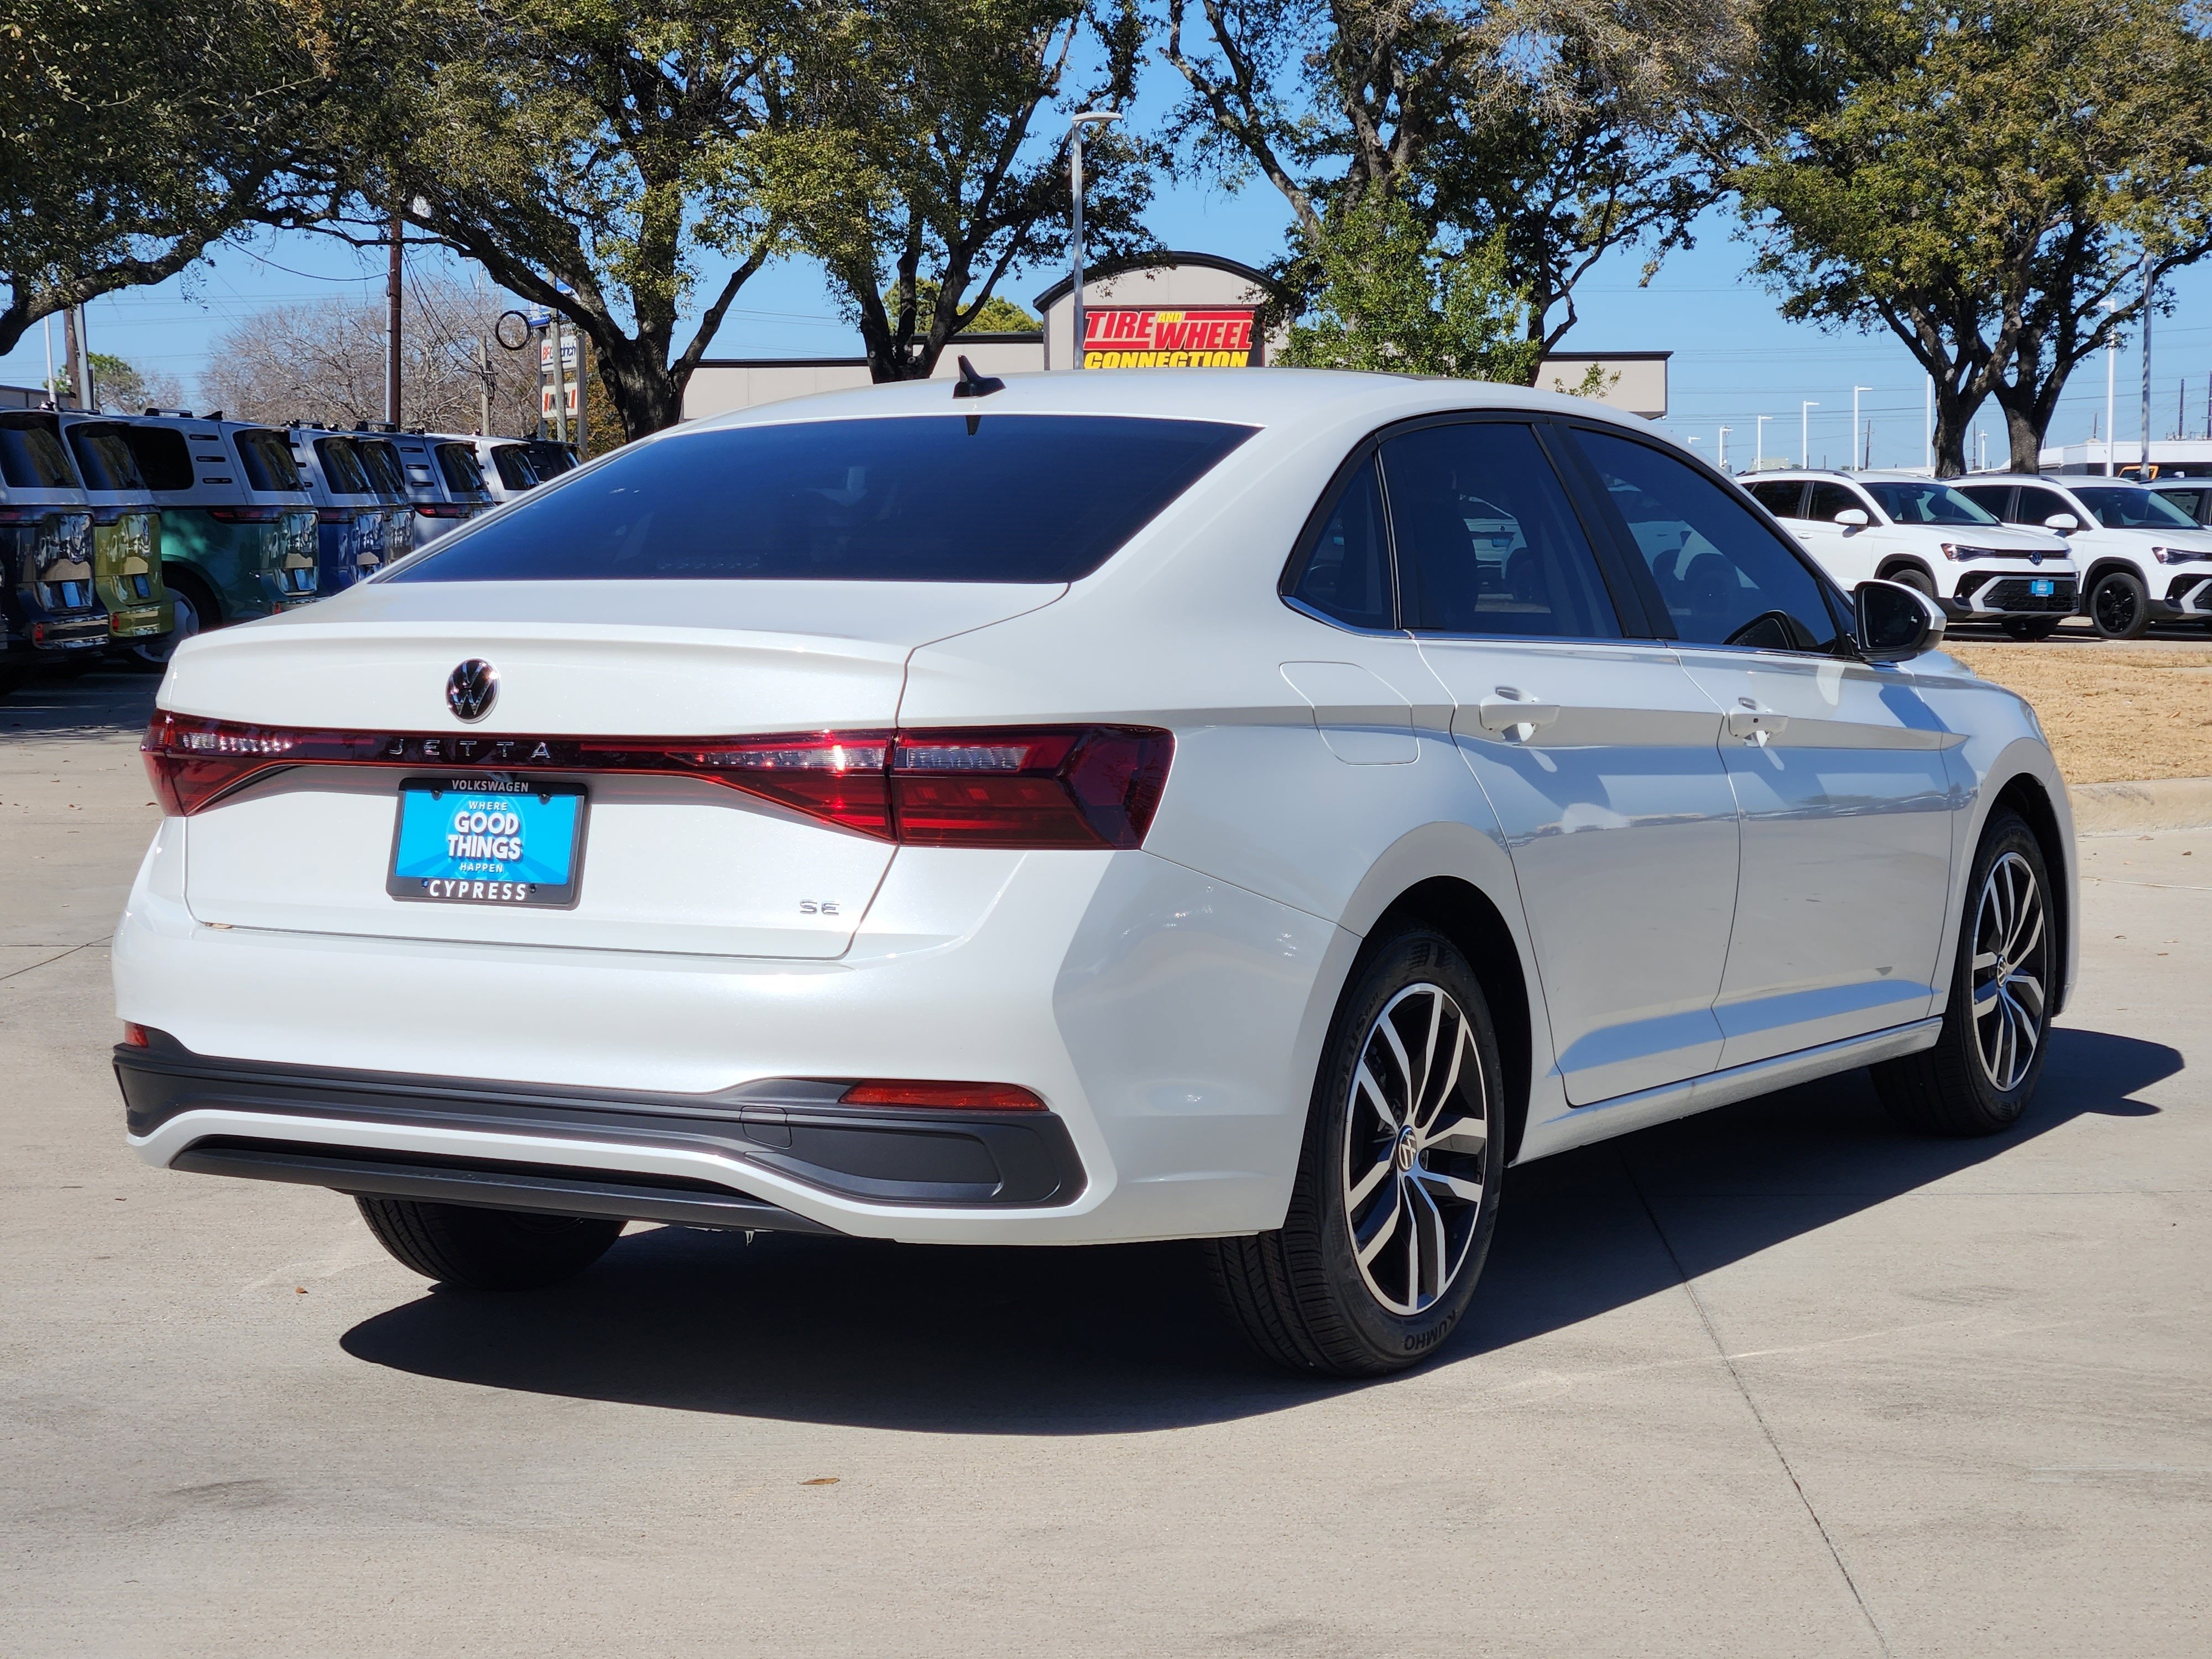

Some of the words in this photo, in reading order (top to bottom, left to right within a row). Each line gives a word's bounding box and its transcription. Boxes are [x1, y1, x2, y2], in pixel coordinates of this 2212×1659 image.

[1086, 311, 1156, 339] TIRE
[1157, 312, 1182, 323] AND
[1155, 320, 1254, 349] WHEEL
[1084, 352, 1249, 369] CONNECTION
[447, 659, 498, 720] VW
[389, 739, 550, 759] JETTA
[452, 780, 529, 792] VOLKSWAGEN
[469, 801, 508, 811] WHERE
[454, 811, 519, 835] GOOD
[448, 834, 523, 860] THINGS
[460, 863, 504, 873] HAPPEN
[429, 880, 526, 901] CYPRESS
[800, 899, 840, 916] SE
[1404, 1310, 1457, 1351] KUMHO
